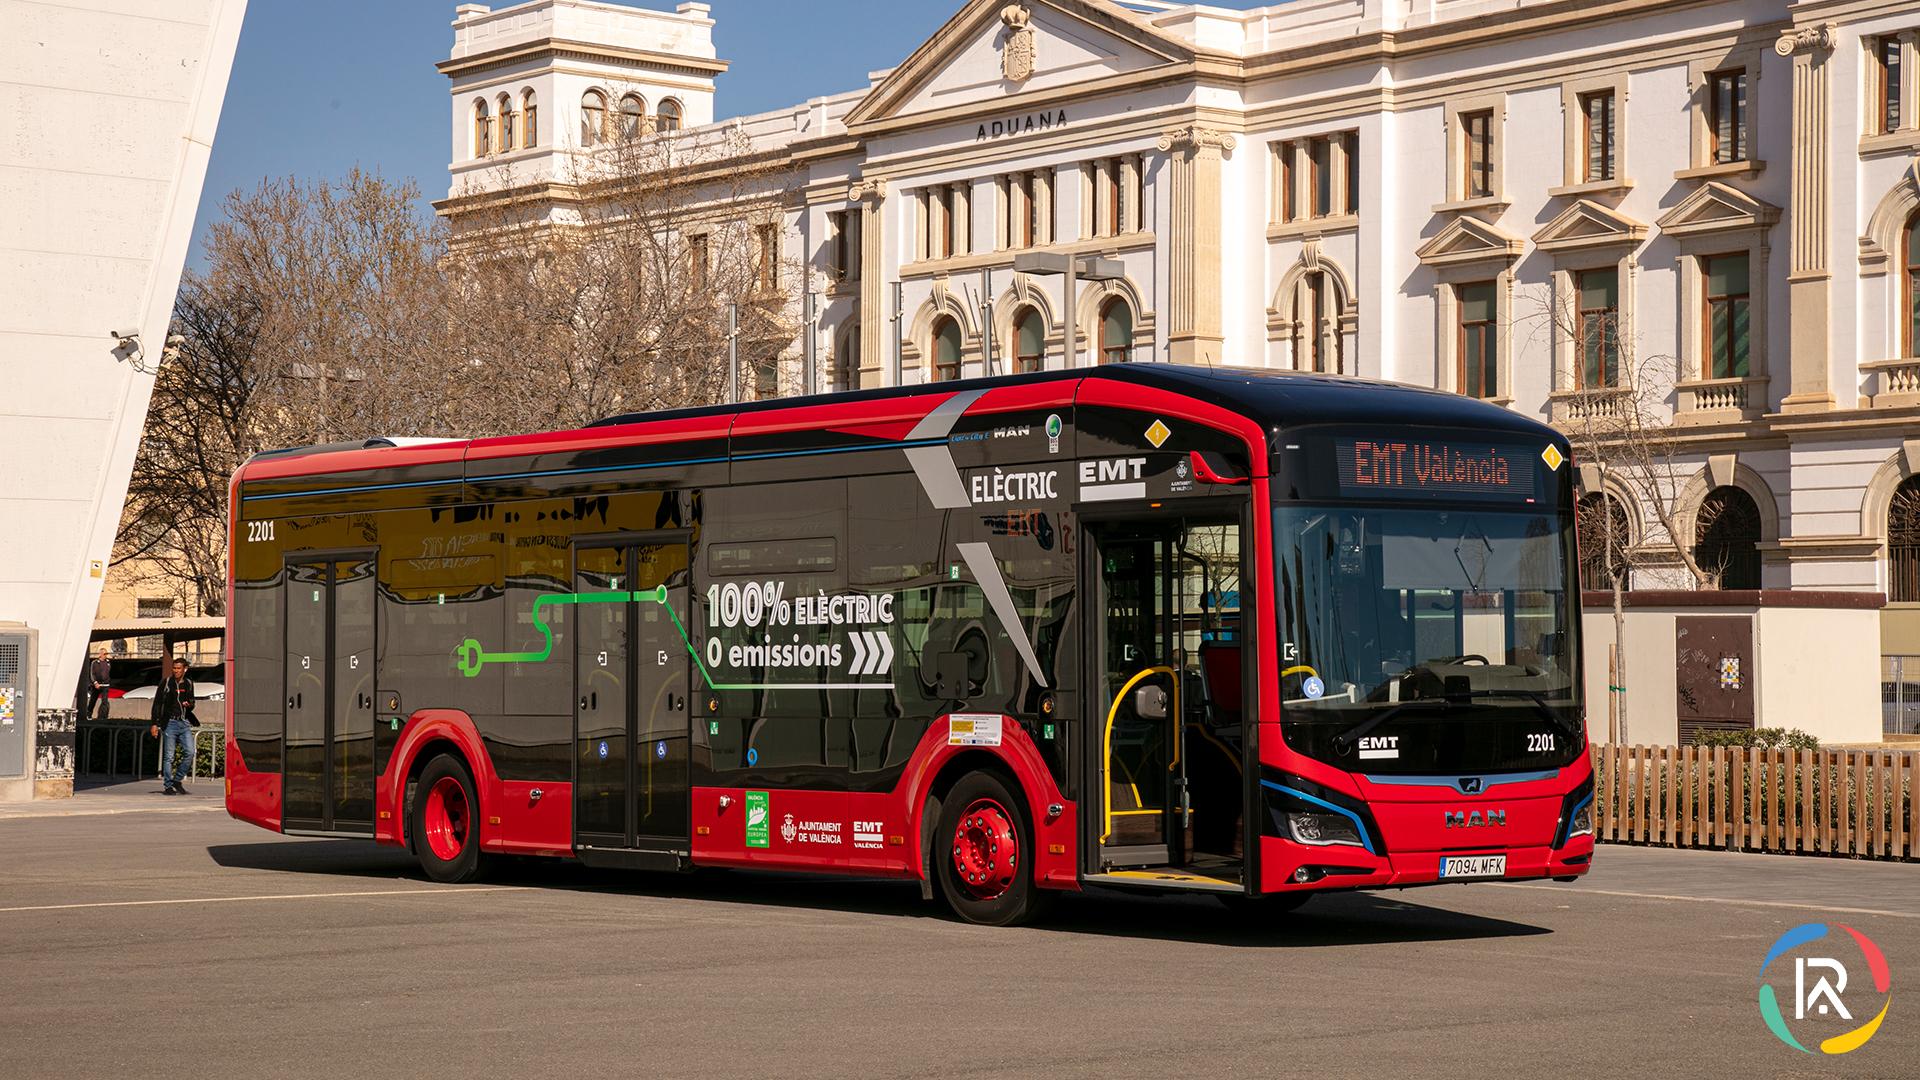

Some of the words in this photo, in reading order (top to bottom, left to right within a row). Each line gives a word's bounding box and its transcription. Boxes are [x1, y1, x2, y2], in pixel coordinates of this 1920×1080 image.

[976, 109, 1067, 142] ADUANA
[994, 425, 1031, 438] MAN
[1079, 457, 1146, 483] EMT
[1355, 442, 1407, 484] EMT
[1414, 444, 1509, 485] València
[972, 467, 1058, 503] ELÈCTRIC
[248, 520, 275, 542] 2201
[706, 581, 791, 628] 100%
[795, 589, 894, 625] ELÈCTRIC
[706, 636, 722, 668] 0
[729, 633, 842, 667] emissions
[1358, 736, 1399, 749] EMT
[1527, 734, 1555, 751] 2201
[799, 821, 842, 832] AJUNTAMENT
[853, 821, 883, 832] EMT
[1445, 809, 1506, 828] MAN
[798, 832, 808, 842] DE
[809, 832, 842, 844] VALÈNCIA
[1447, 859, 1477, 875] 7094
[1481, 857, 1503, 874] MFK
